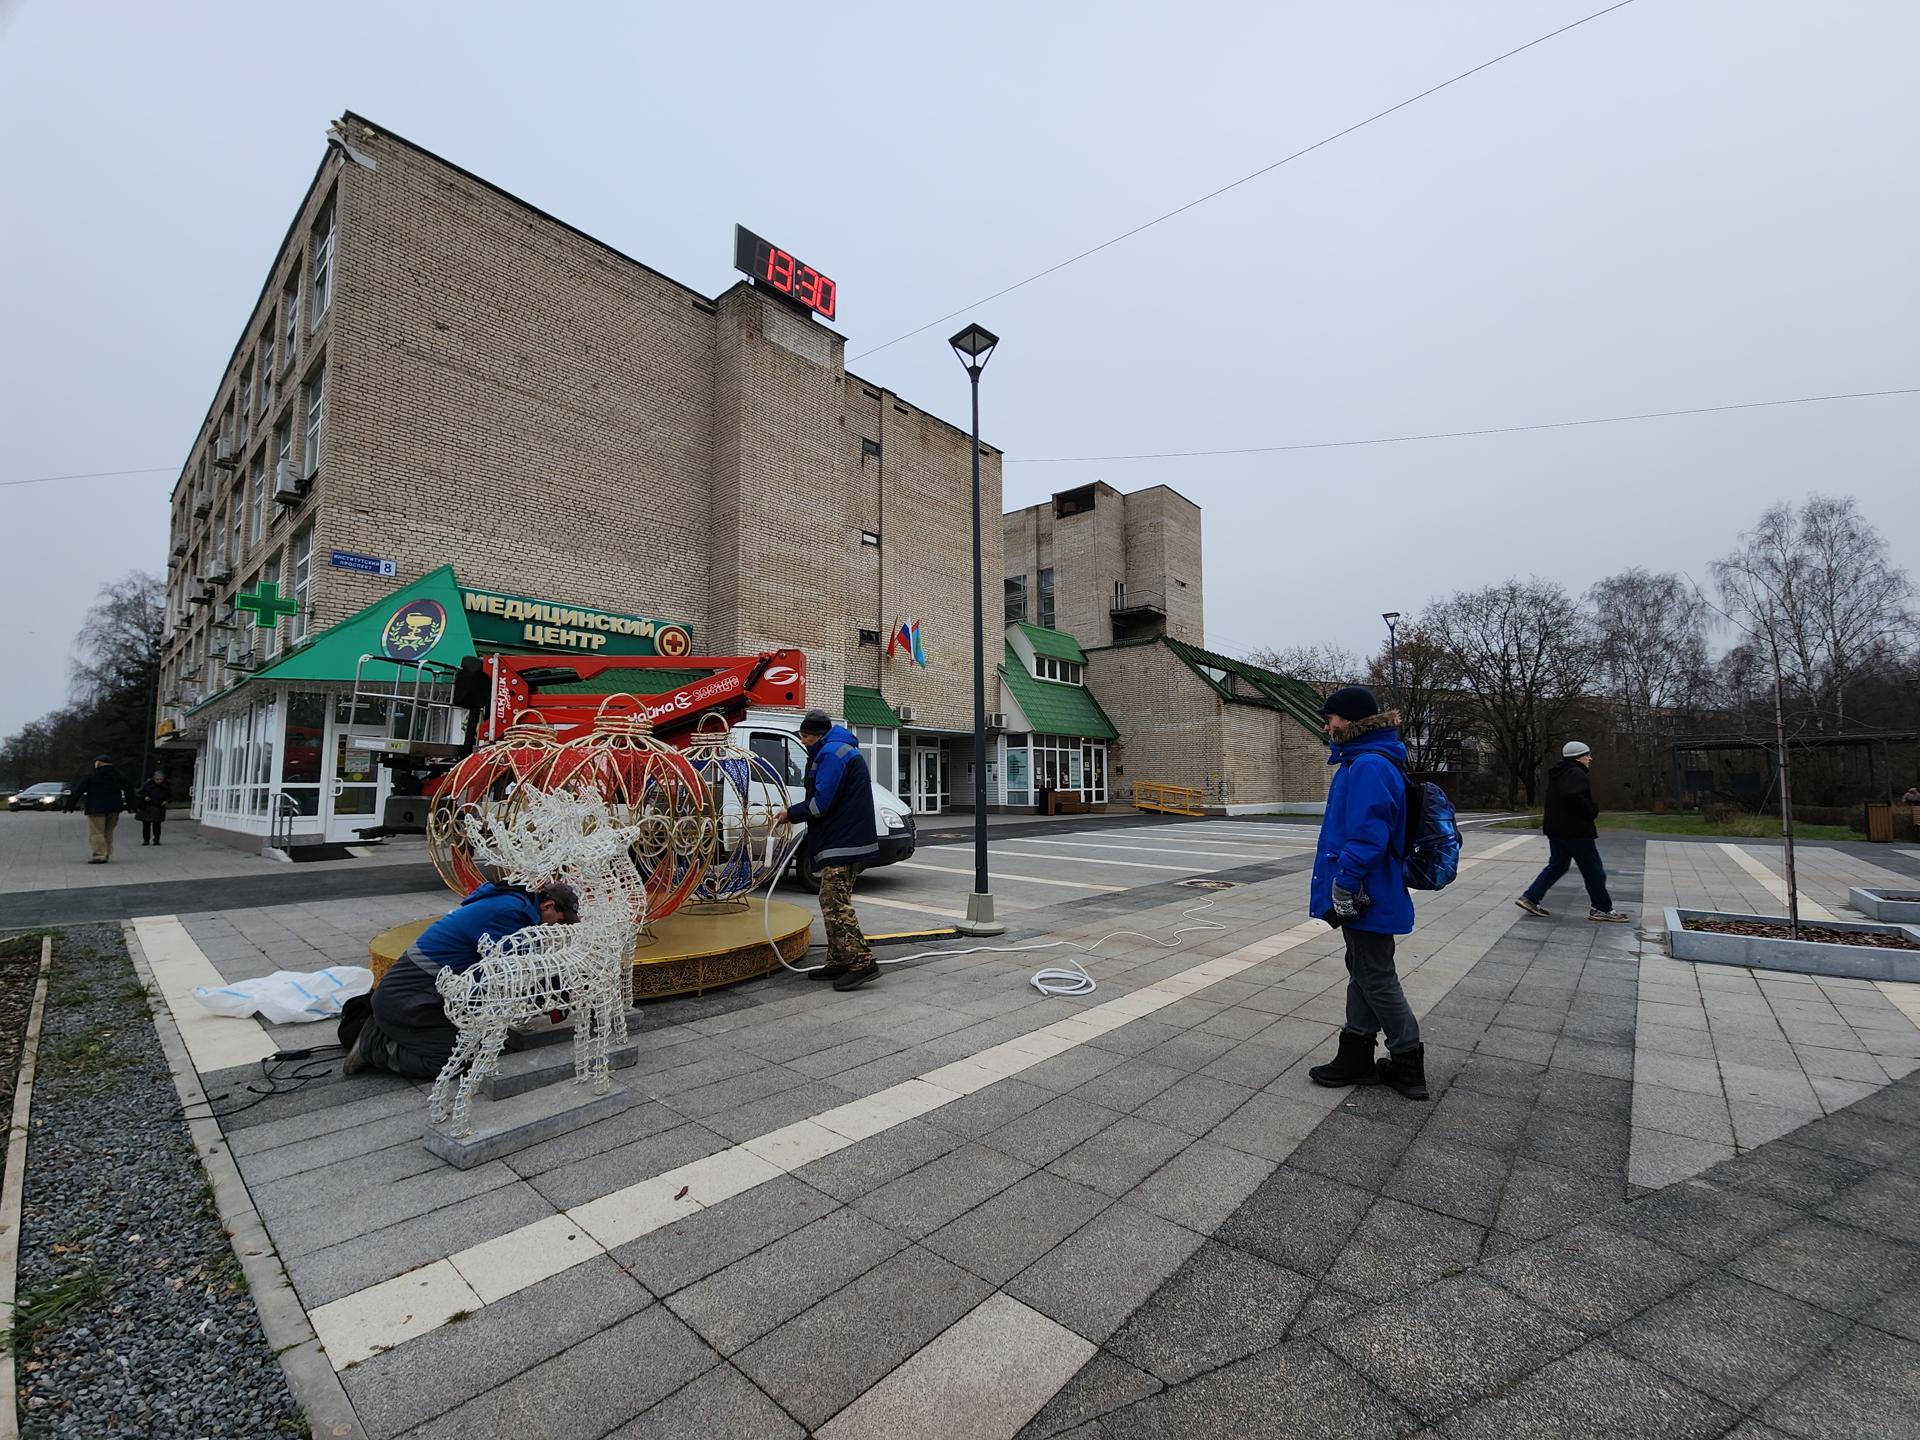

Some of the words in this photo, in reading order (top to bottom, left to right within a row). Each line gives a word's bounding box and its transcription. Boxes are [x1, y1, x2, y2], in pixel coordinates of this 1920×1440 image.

[767, 248, 835, 316] 13:30
[339, 560, 372, 570] ПРОСПЕКТ
[383, 563, 392, 573] 8
[465, 592, 655, 637] МЕДИЦИНСКИЙ
[523, 623, 607, 650] ЦЕНТР
